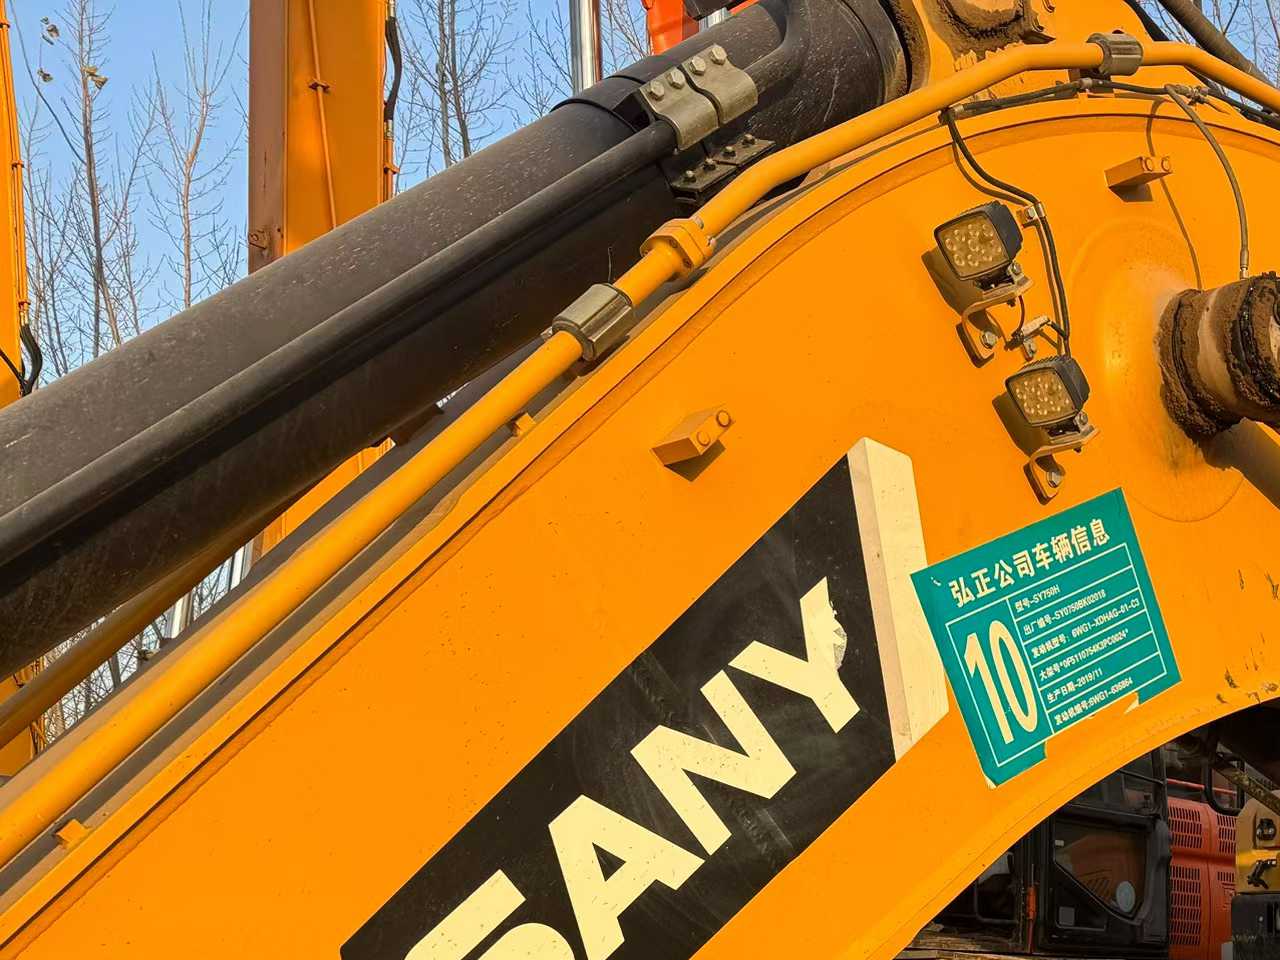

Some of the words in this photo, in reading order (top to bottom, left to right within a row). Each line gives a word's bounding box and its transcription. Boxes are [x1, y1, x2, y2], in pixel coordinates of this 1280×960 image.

[949, 518, 1109, 607] 弘正公司车辆信息
[963, 620, 1038, 744] 10
